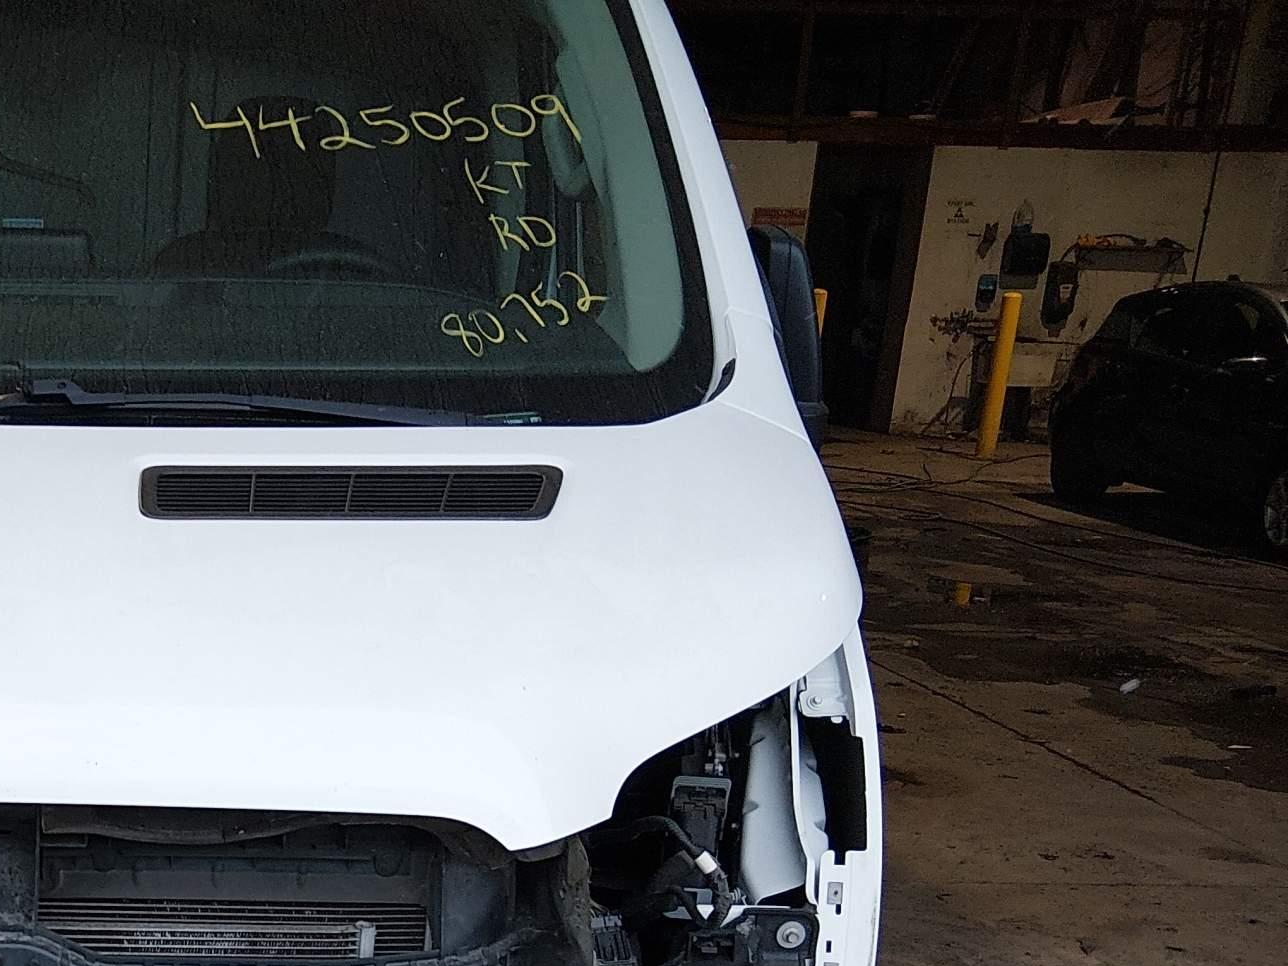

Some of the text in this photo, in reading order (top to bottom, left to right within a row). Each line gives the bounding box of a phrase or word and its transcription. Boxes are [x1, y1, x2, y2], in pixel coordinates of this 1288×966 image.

[189, 93, 583, 158] 44250509
[464, 157, 532, 204] KT
[487, 213, 557, 251] RD
[440, 270, 609, 358] 80,752
